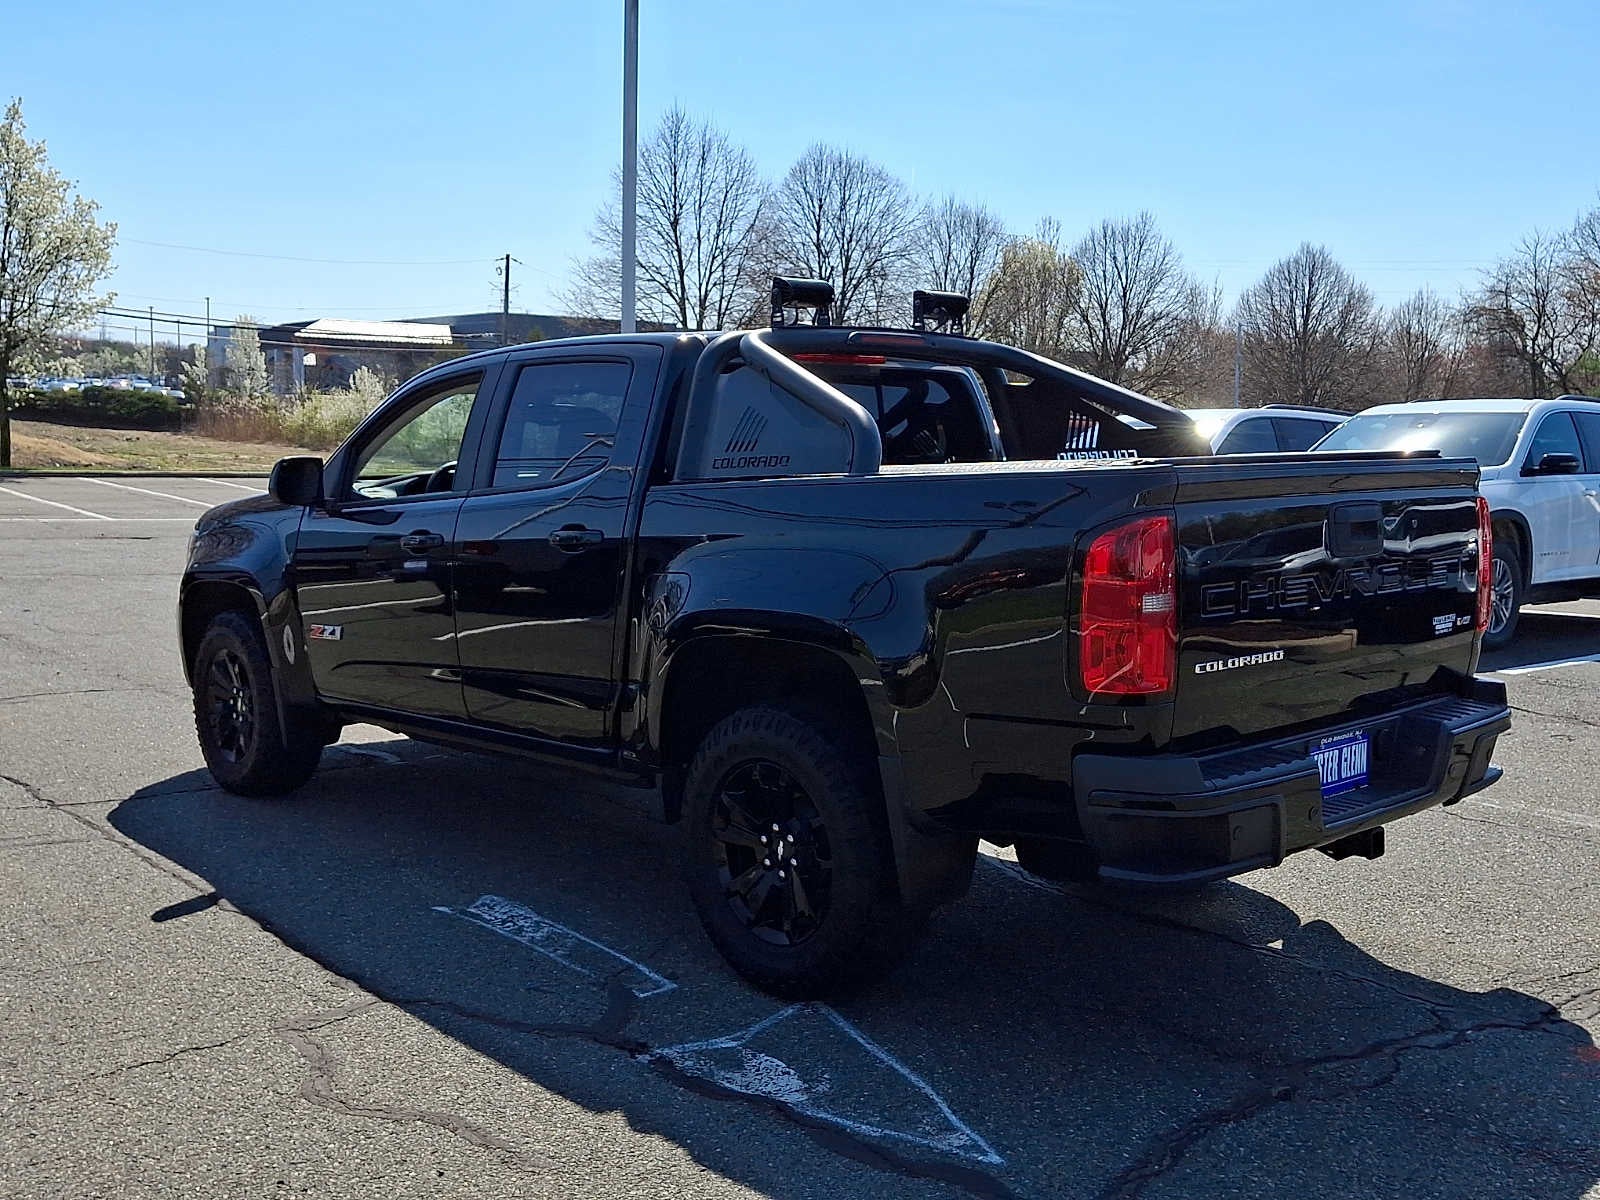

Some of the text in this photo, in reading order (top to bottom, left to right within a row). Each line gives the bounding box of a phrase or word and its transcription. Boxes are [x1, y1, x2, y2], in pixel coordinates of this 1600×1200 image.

[712, 455, 790, 470] COLORADO
[310, 624, 341, 640] Z71
[1194, 649, 1285, 675] COLORADO
[1314, 742, 1367, 784] STER GLENN
